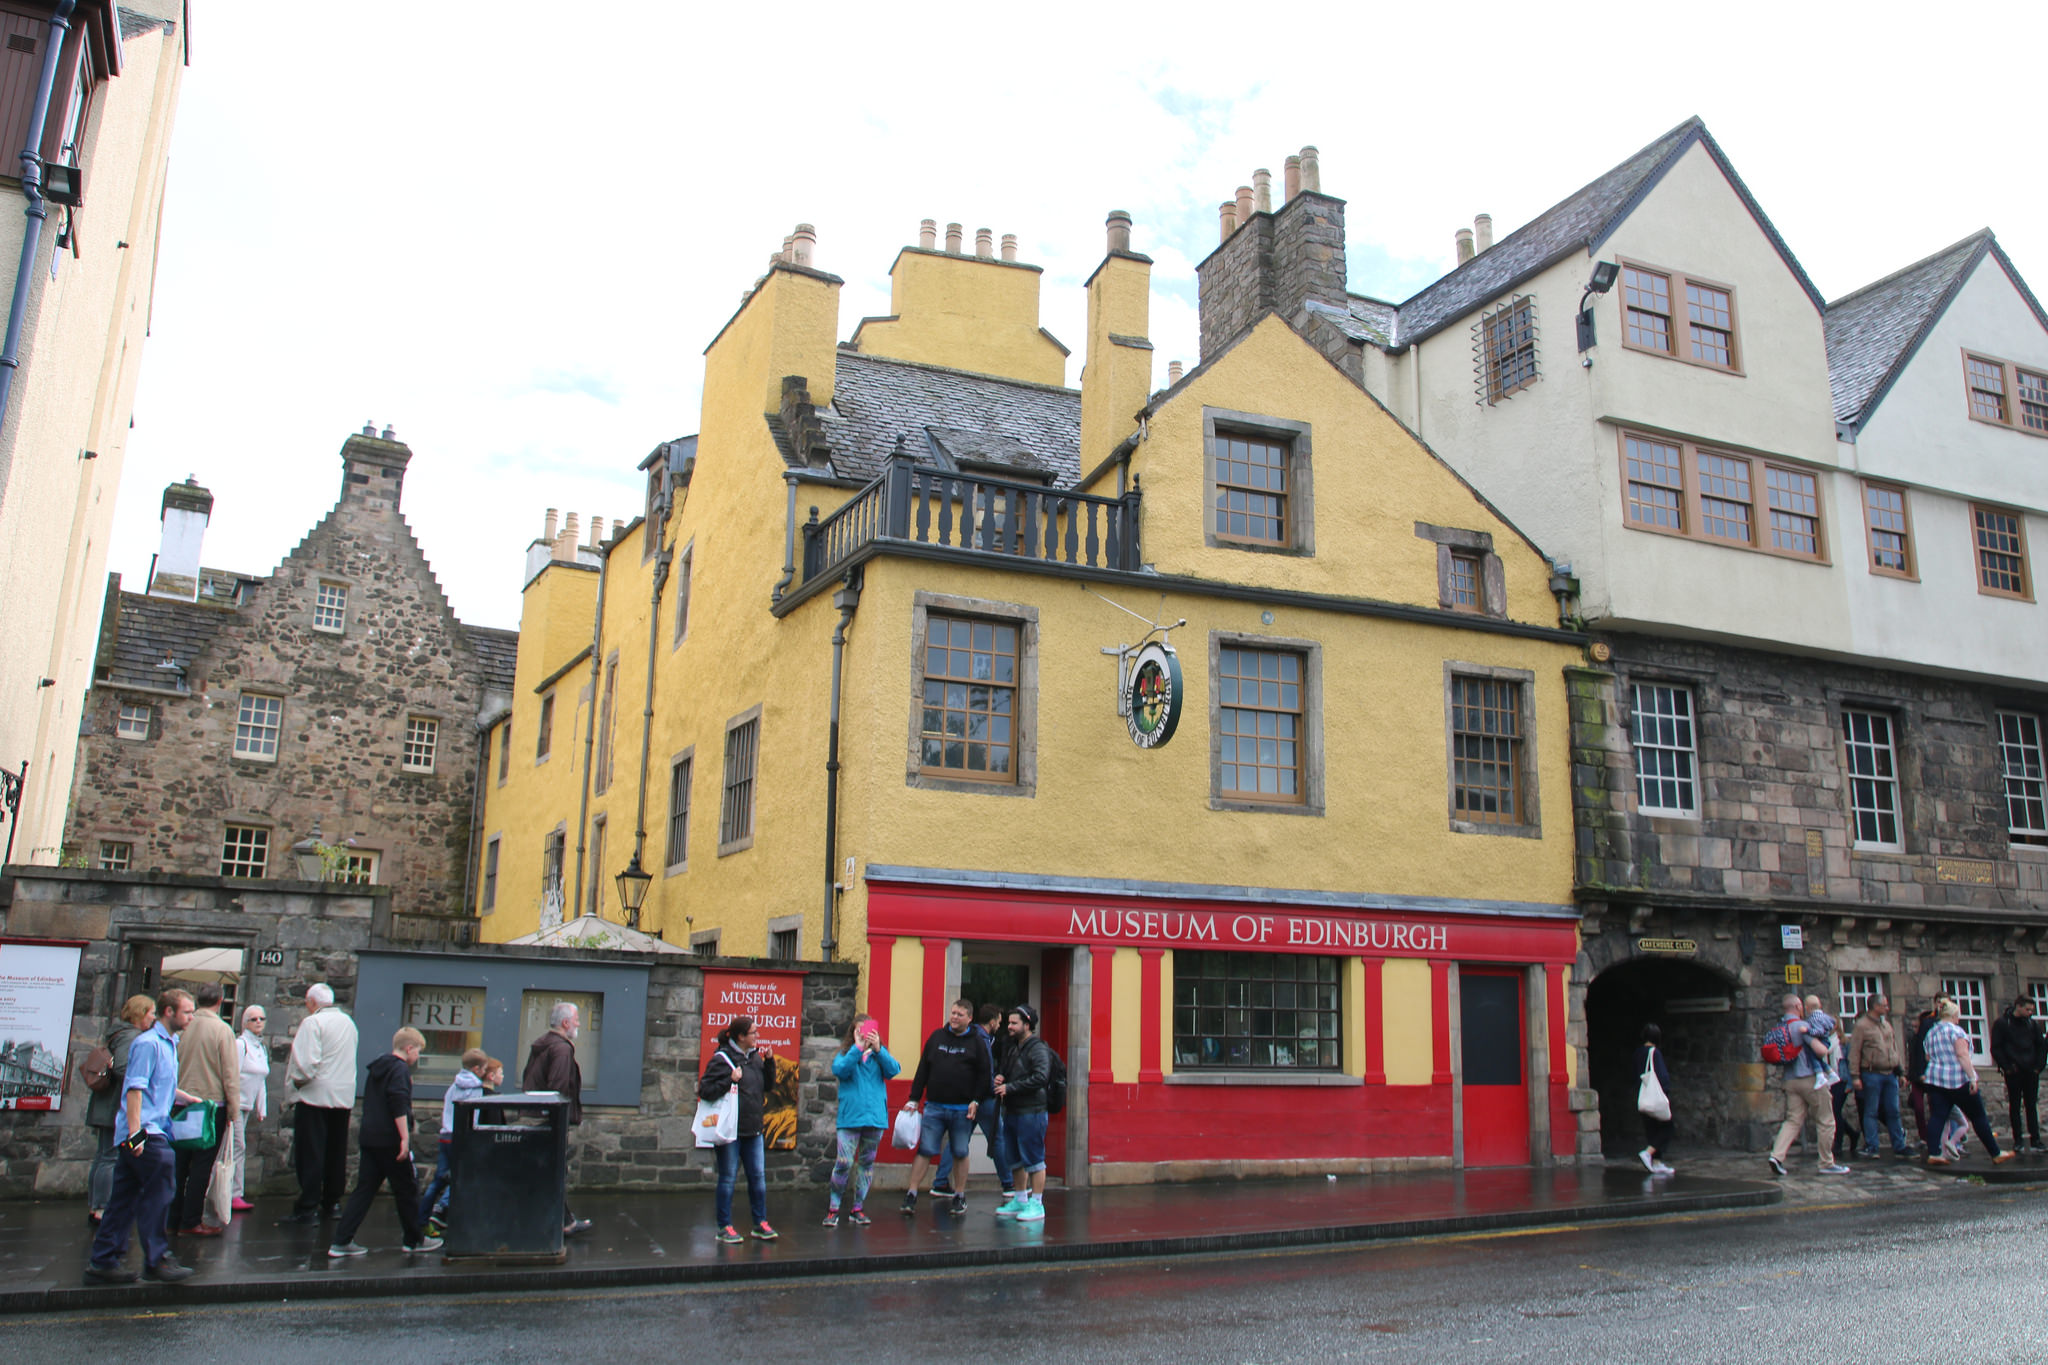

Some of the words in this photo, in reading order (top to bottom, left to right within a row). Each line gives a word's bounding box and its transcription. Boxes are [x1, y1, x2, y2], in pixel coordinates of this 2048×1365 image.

[1067, 908, 1220, 942] MUSEUM
[1232, 915, 1275, 943] OF
[1287, 918, 1449, 951] EDINBURGH
[1641, 941, 1674, 949] BAKEHOUSE
[1675, 941, 1694, 949] CLOSE
[260, 951, 282, 964] 140
[732, 982, 759, 990] Welcome
[767, 982, 777, 991] the
[720, 991, 786, 1006] MUSEUM
[408, 1003, 484, 1026] FREE
[746, 1006, 759, 1014] OF
[707, 1013, 797, 1029] EDIURGH
[495, 1133, 522, 1143] Litter
